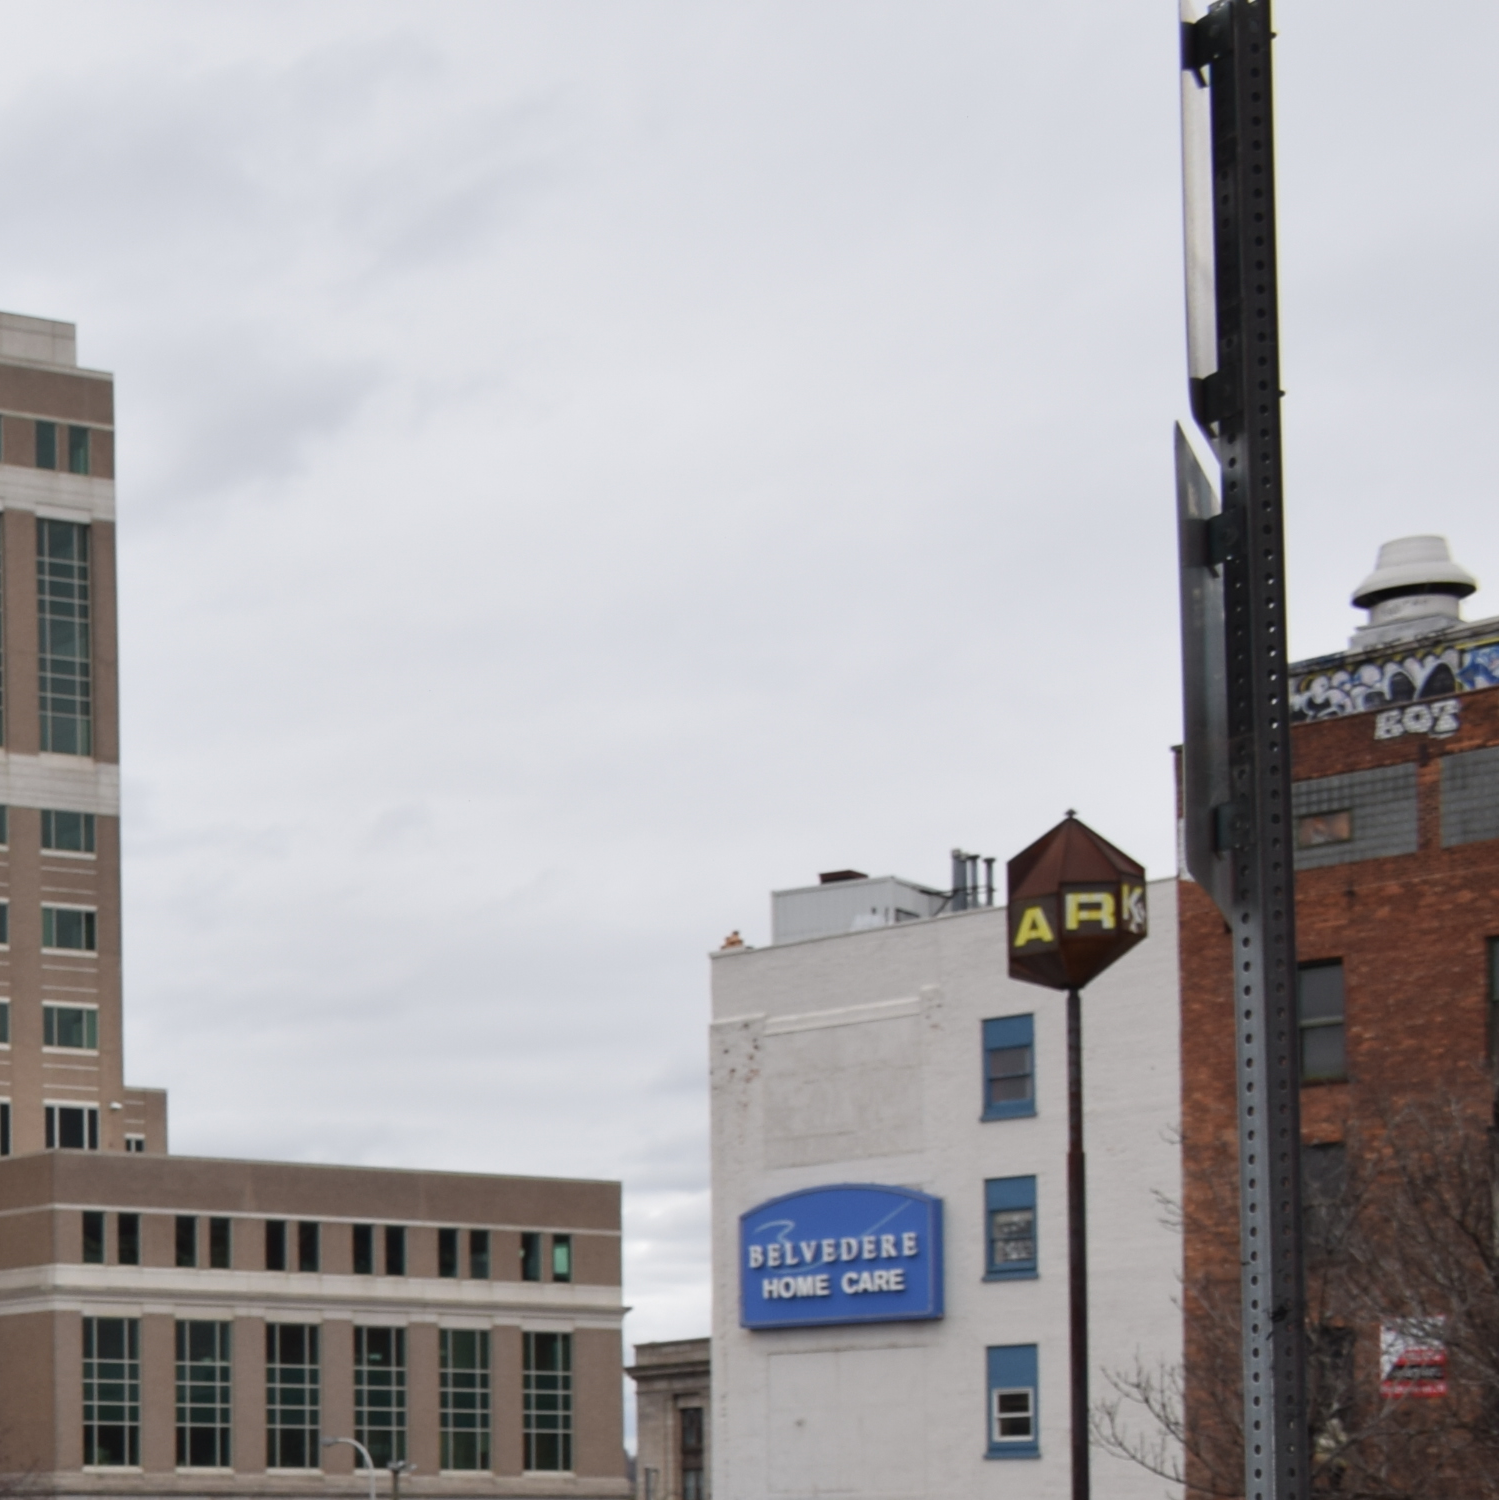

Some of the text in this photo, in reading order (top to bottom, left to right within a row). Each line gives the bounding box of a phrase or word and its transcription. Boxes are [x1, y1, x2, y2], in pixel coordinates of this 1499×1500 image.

[748, 1231, 919, 1269] BELVEDERE
[762, 1268, 907, 1300] HOME CARE
